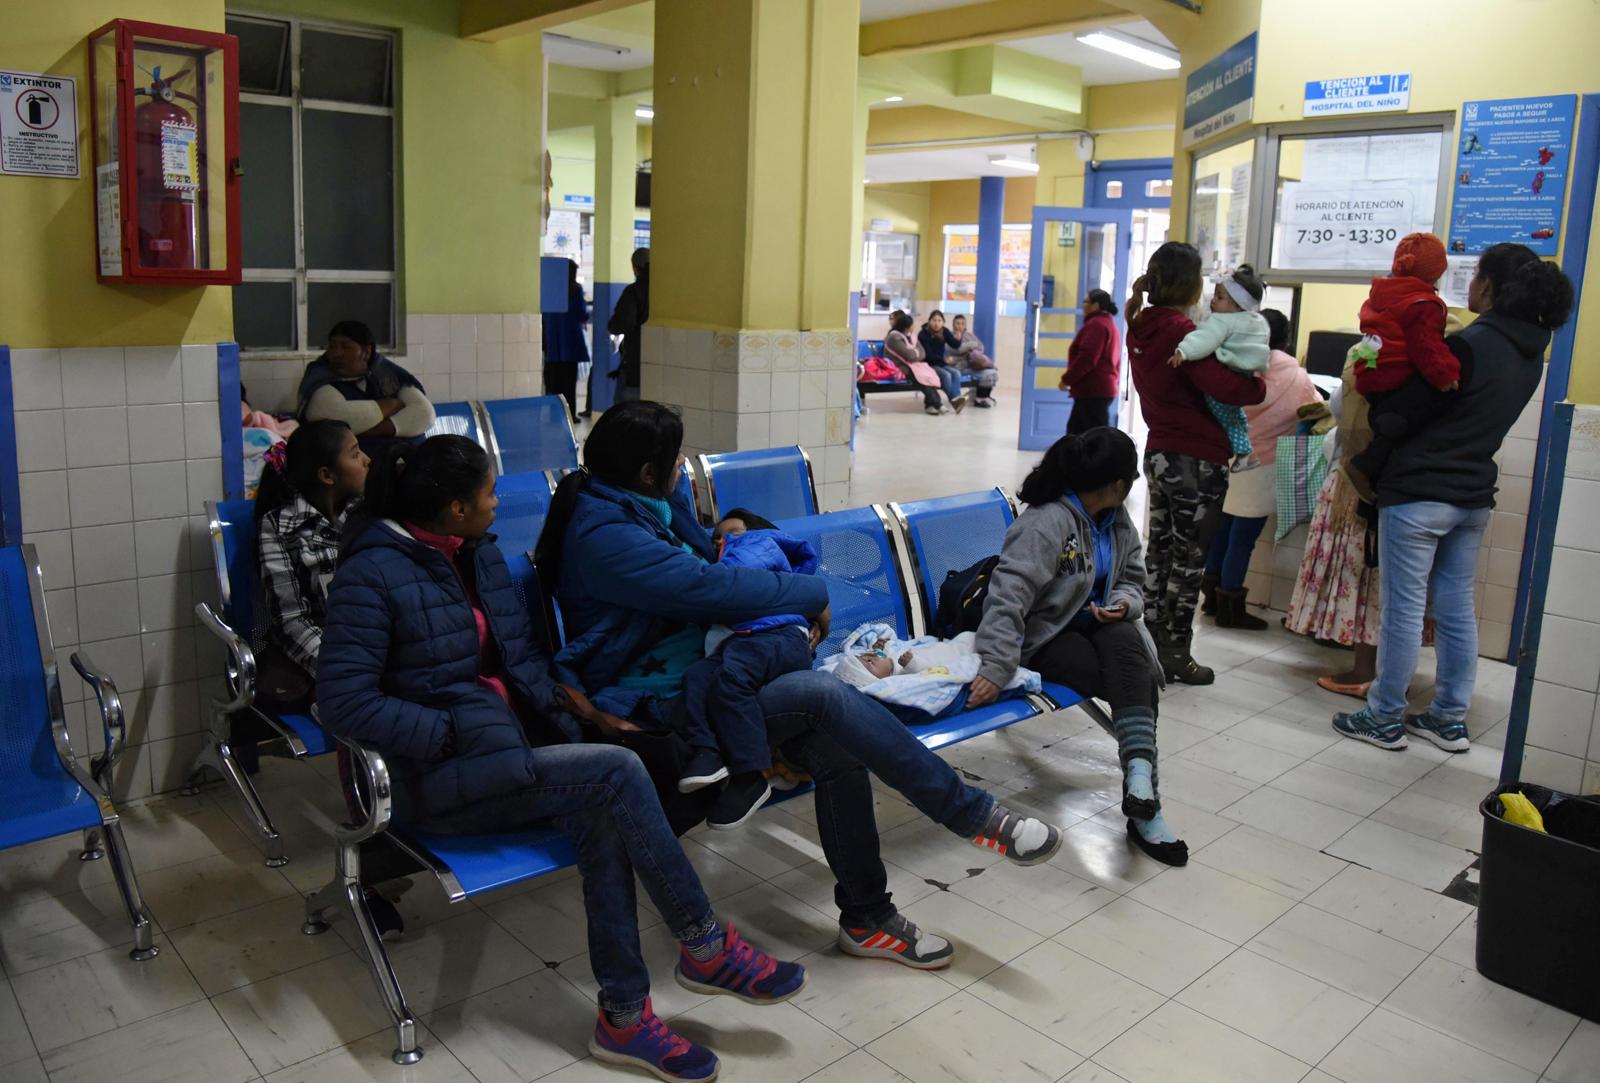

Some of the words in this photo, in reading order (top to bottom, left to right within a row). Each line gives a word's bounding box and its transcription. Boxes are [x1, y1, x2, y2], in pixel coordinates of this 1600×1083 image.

[13, 77, 62, 89] EXTINTOR
[1369, 76, 1384, 86] AL
[1325, 86, 1370, 98] CLIENTE
[1311, 102, 1354, 111] HOSPITAL
[1357, 99, 1374, 108] DEL
[1490, 104, 1525, 112] PACIENTES
[1526, 102, 1553, 110] NUEVOS
[19, 131, 59, 139] INSTRUCTIVO
[1295, 201, 1338, 210] HORARIO
[1340, 201, 1351, 210] DE
[1353, 199, 1404, 209] ATENCIÓN
[1321, 213, 1333, 221] AL
[1297, 229, 1333, 244] 7:30
[1349, 228, 1397, 244] 13:30
